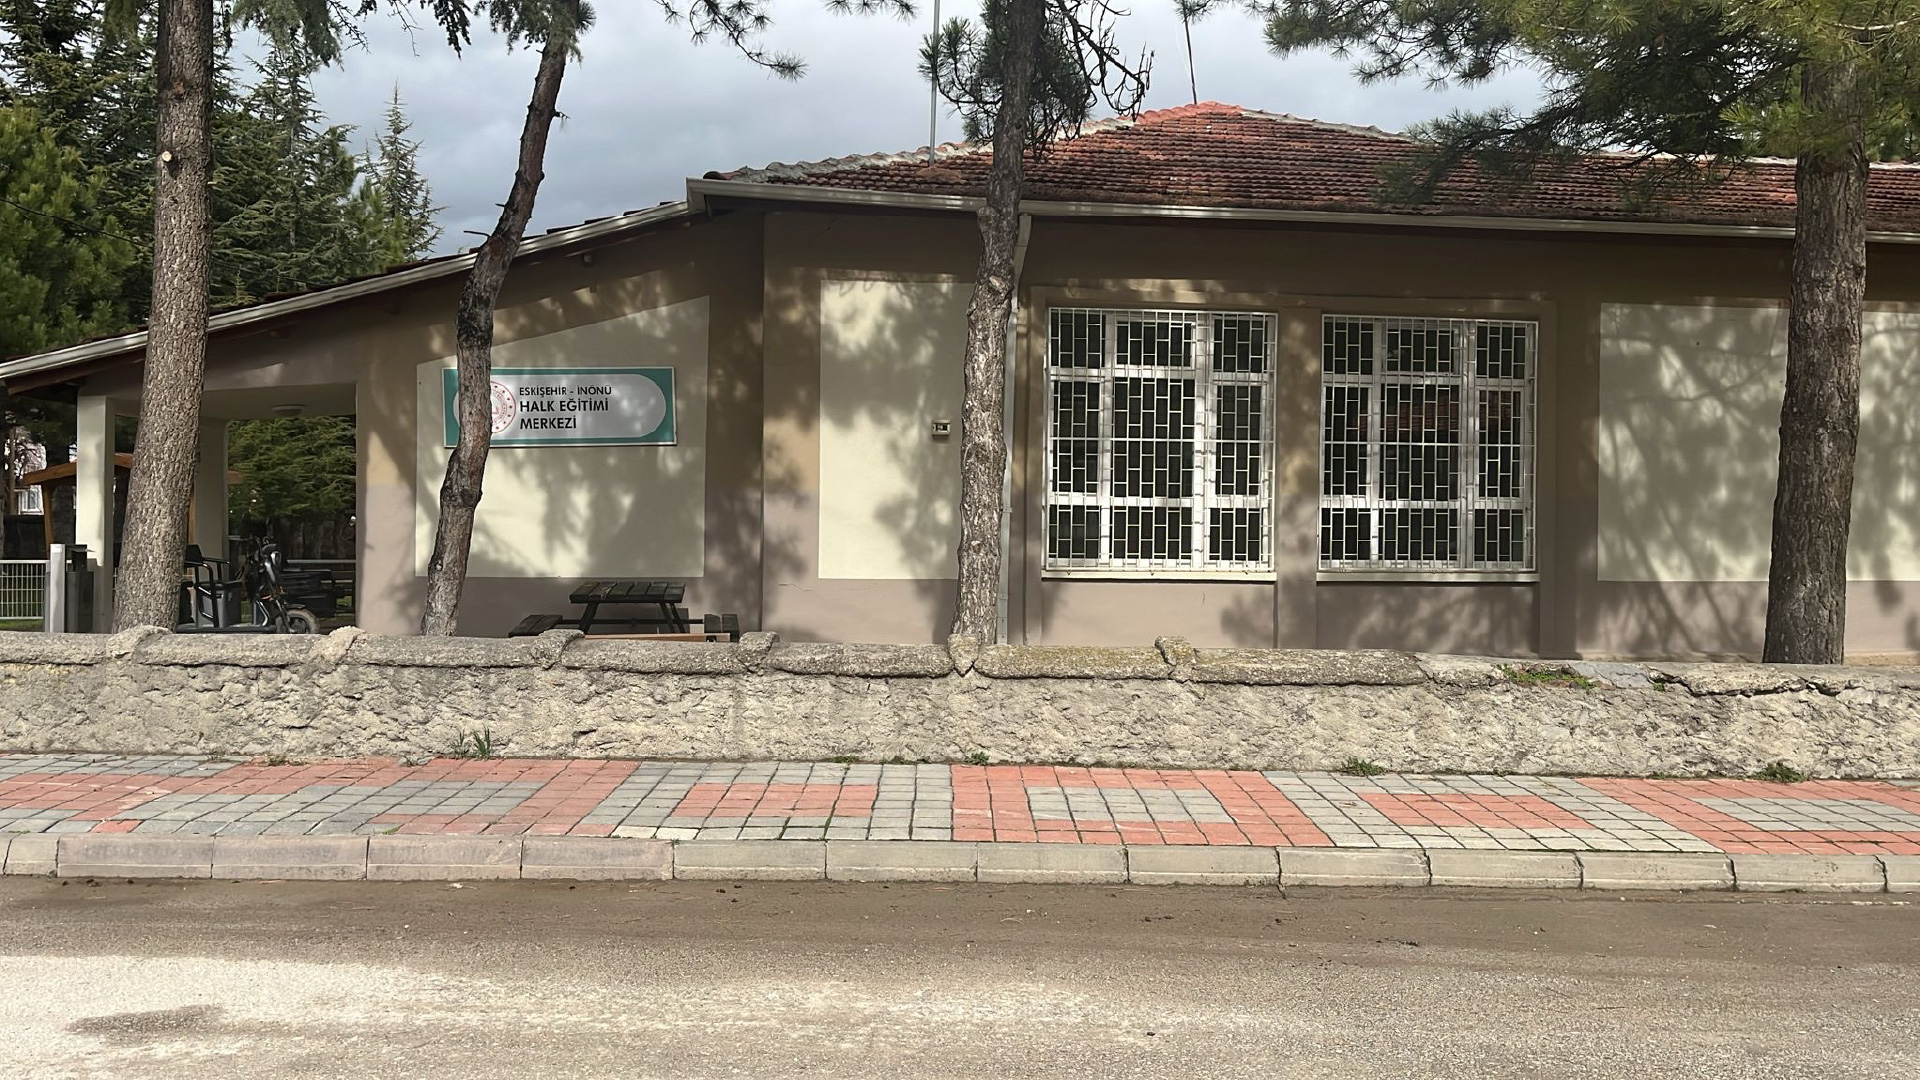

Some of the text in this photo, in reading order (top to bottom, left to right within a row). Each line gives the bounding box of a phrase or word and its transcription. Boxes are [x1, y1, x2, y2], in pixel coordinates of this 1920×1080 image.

[519, 385, 567, 398] ESKİŞEHİR
[577, 384, 612, 396] İNÖNÜ
[520, 397, 609, 412] HALK EĞİTİMİ
[520, 415, 577, 430] MERKEZİ
